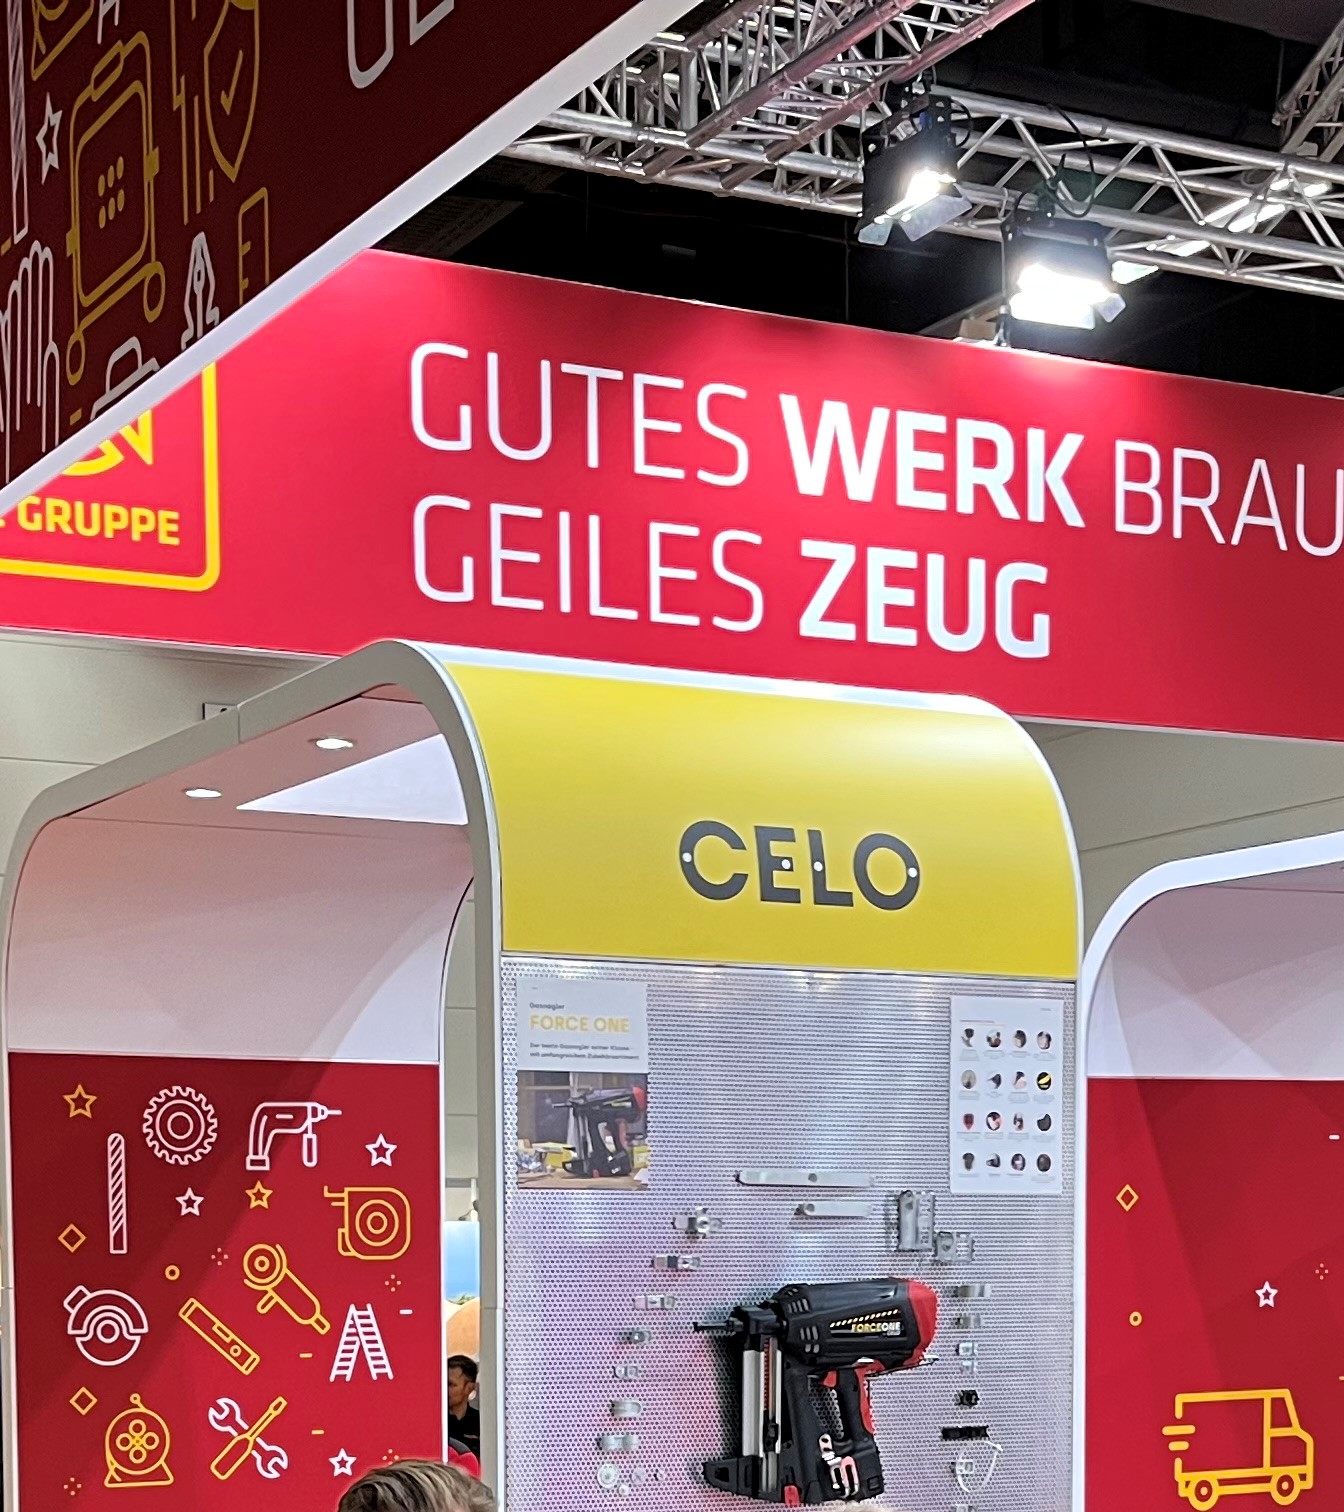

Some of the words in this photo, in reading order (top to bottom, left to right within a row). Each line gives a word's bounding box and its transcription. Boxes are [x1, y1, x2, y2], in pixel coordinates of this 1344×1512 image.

[411, 342, 750, 488] GUTES
[779, 392, 1087, 529] WERK
[17, 495, 181, 546] GRUPPE
[413, 495, 766, 633] GEILES
[799, 538, 1051, 660] ZEUG
[679, 820, 922, 912] CELO
[529, 1014, 589, 1032] FORCE
[593, 1017, 630, 1033] ONE
